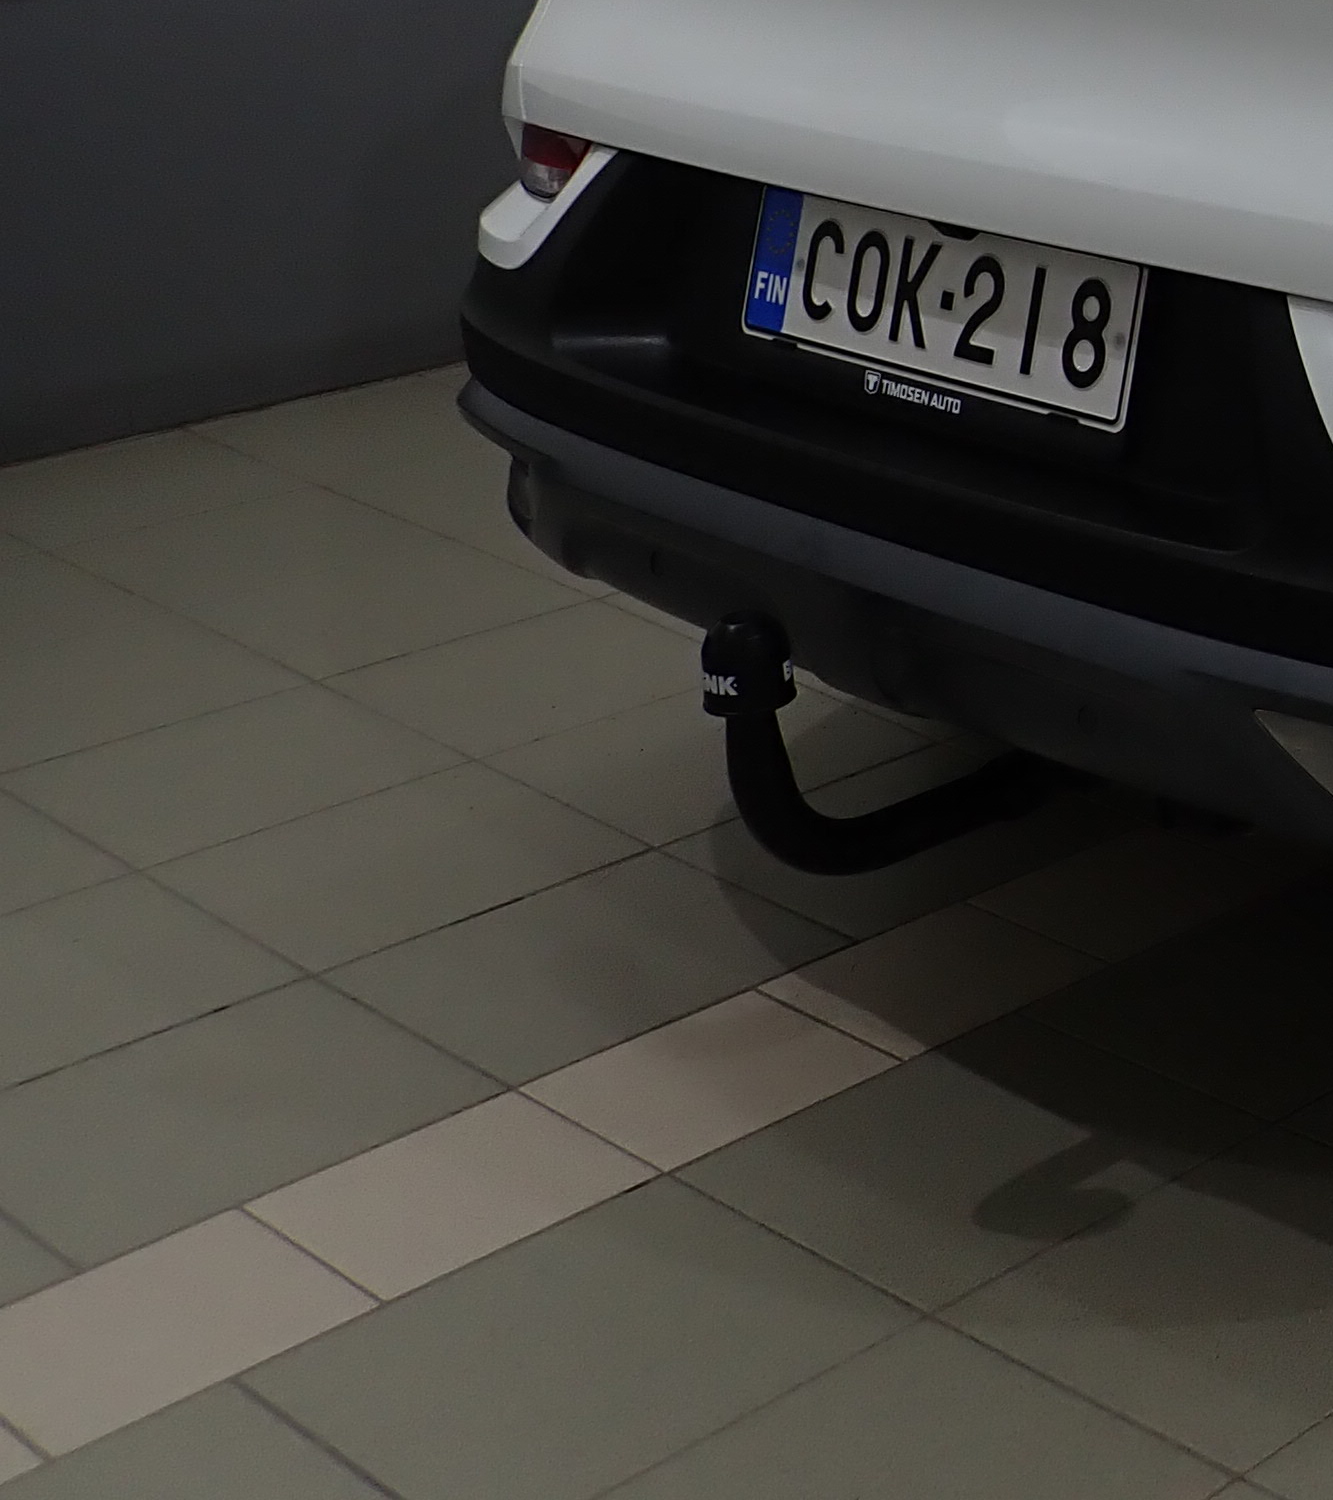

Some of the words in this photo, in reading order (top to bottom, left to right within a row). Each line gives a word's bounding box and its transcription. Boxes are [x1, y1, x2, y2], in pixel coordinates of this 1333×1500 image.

[754, 271, 789, 306] FIN
[802, 218, 1113, 389] COK-218
[881, 379, 931, 406] TIMOSEN
[930, 392, 962, 415] AUTO
